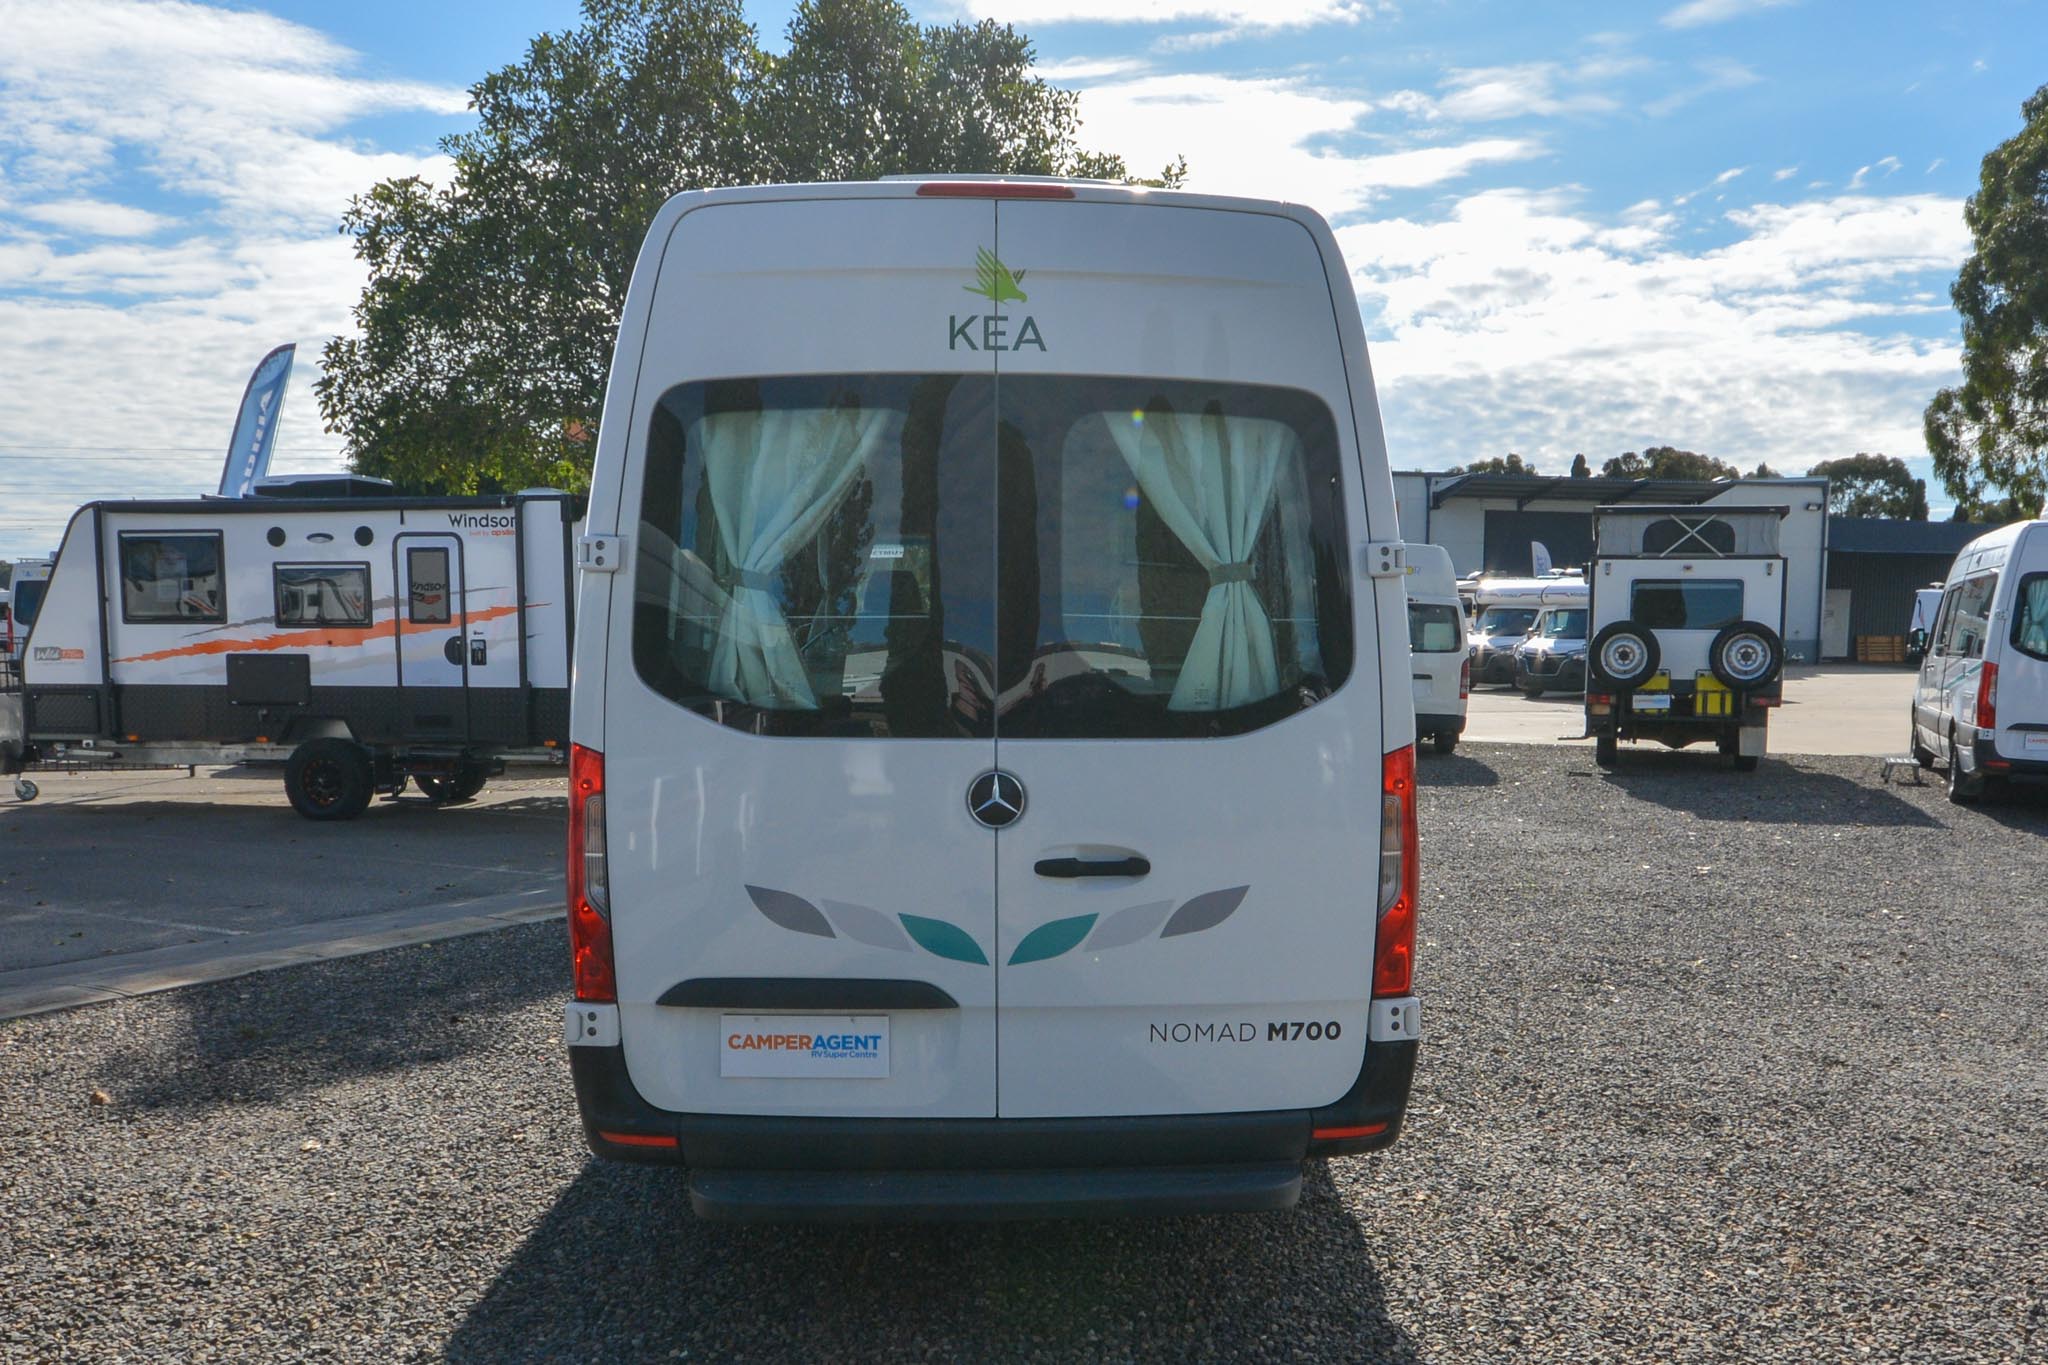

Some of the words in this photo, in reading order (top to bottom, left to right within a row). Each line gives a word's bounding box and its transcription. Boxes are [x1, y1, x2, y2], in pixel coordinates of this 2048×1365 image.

[949, 315, 1047, 352] KEA
[448, 513, 516, 528] Windsor
[1150, 1023, 1257, 1042] NOMAD
[1268, 1021, 1342, 1041] M700
[728, 1034, 882, 1050] CAMPERAGENT
[824, 1051, 848, 1060] Super
